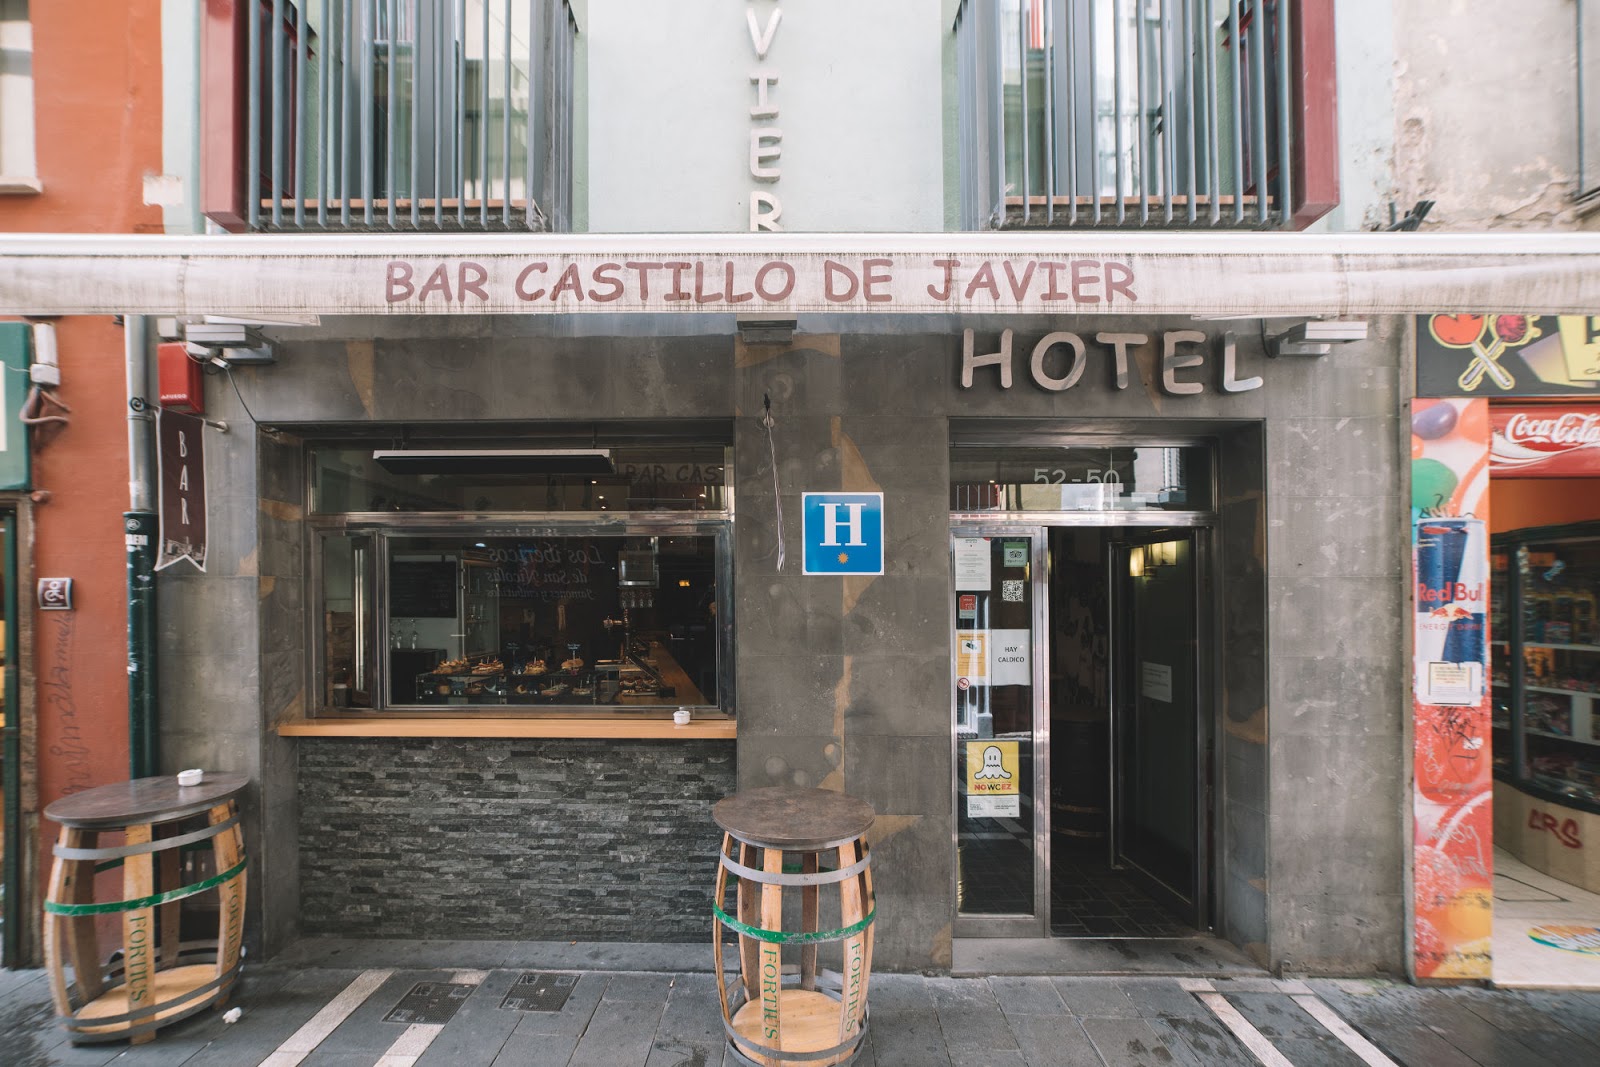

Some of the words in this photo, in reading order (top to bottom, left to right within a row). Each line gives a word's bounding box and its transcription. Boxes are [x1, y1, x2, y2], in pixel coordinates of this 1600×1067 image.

[747, 0, 784, 231] VIER
[385, 261, 489, 302] BAR
[514, 261, 796, 302] CASTILLO
[824, 259, 893, 302] DE
[927, 259, 1138, 302] JAVIER
[961, 328, 1264, 395] HOTEL
[178, 430, 190, 525] BAR
[676, 463, 724, 481] CAS
[1034, 468, 1120, 491] 52-50
[819, 503, 867, 546] H
[1418, 582, 1452, 602] Red
[129, 915, 148, 1002] FORTIUS
[845, 942, 862, 1033] FORTIUS
[763, 949, 779, 1041] FORTIUS
